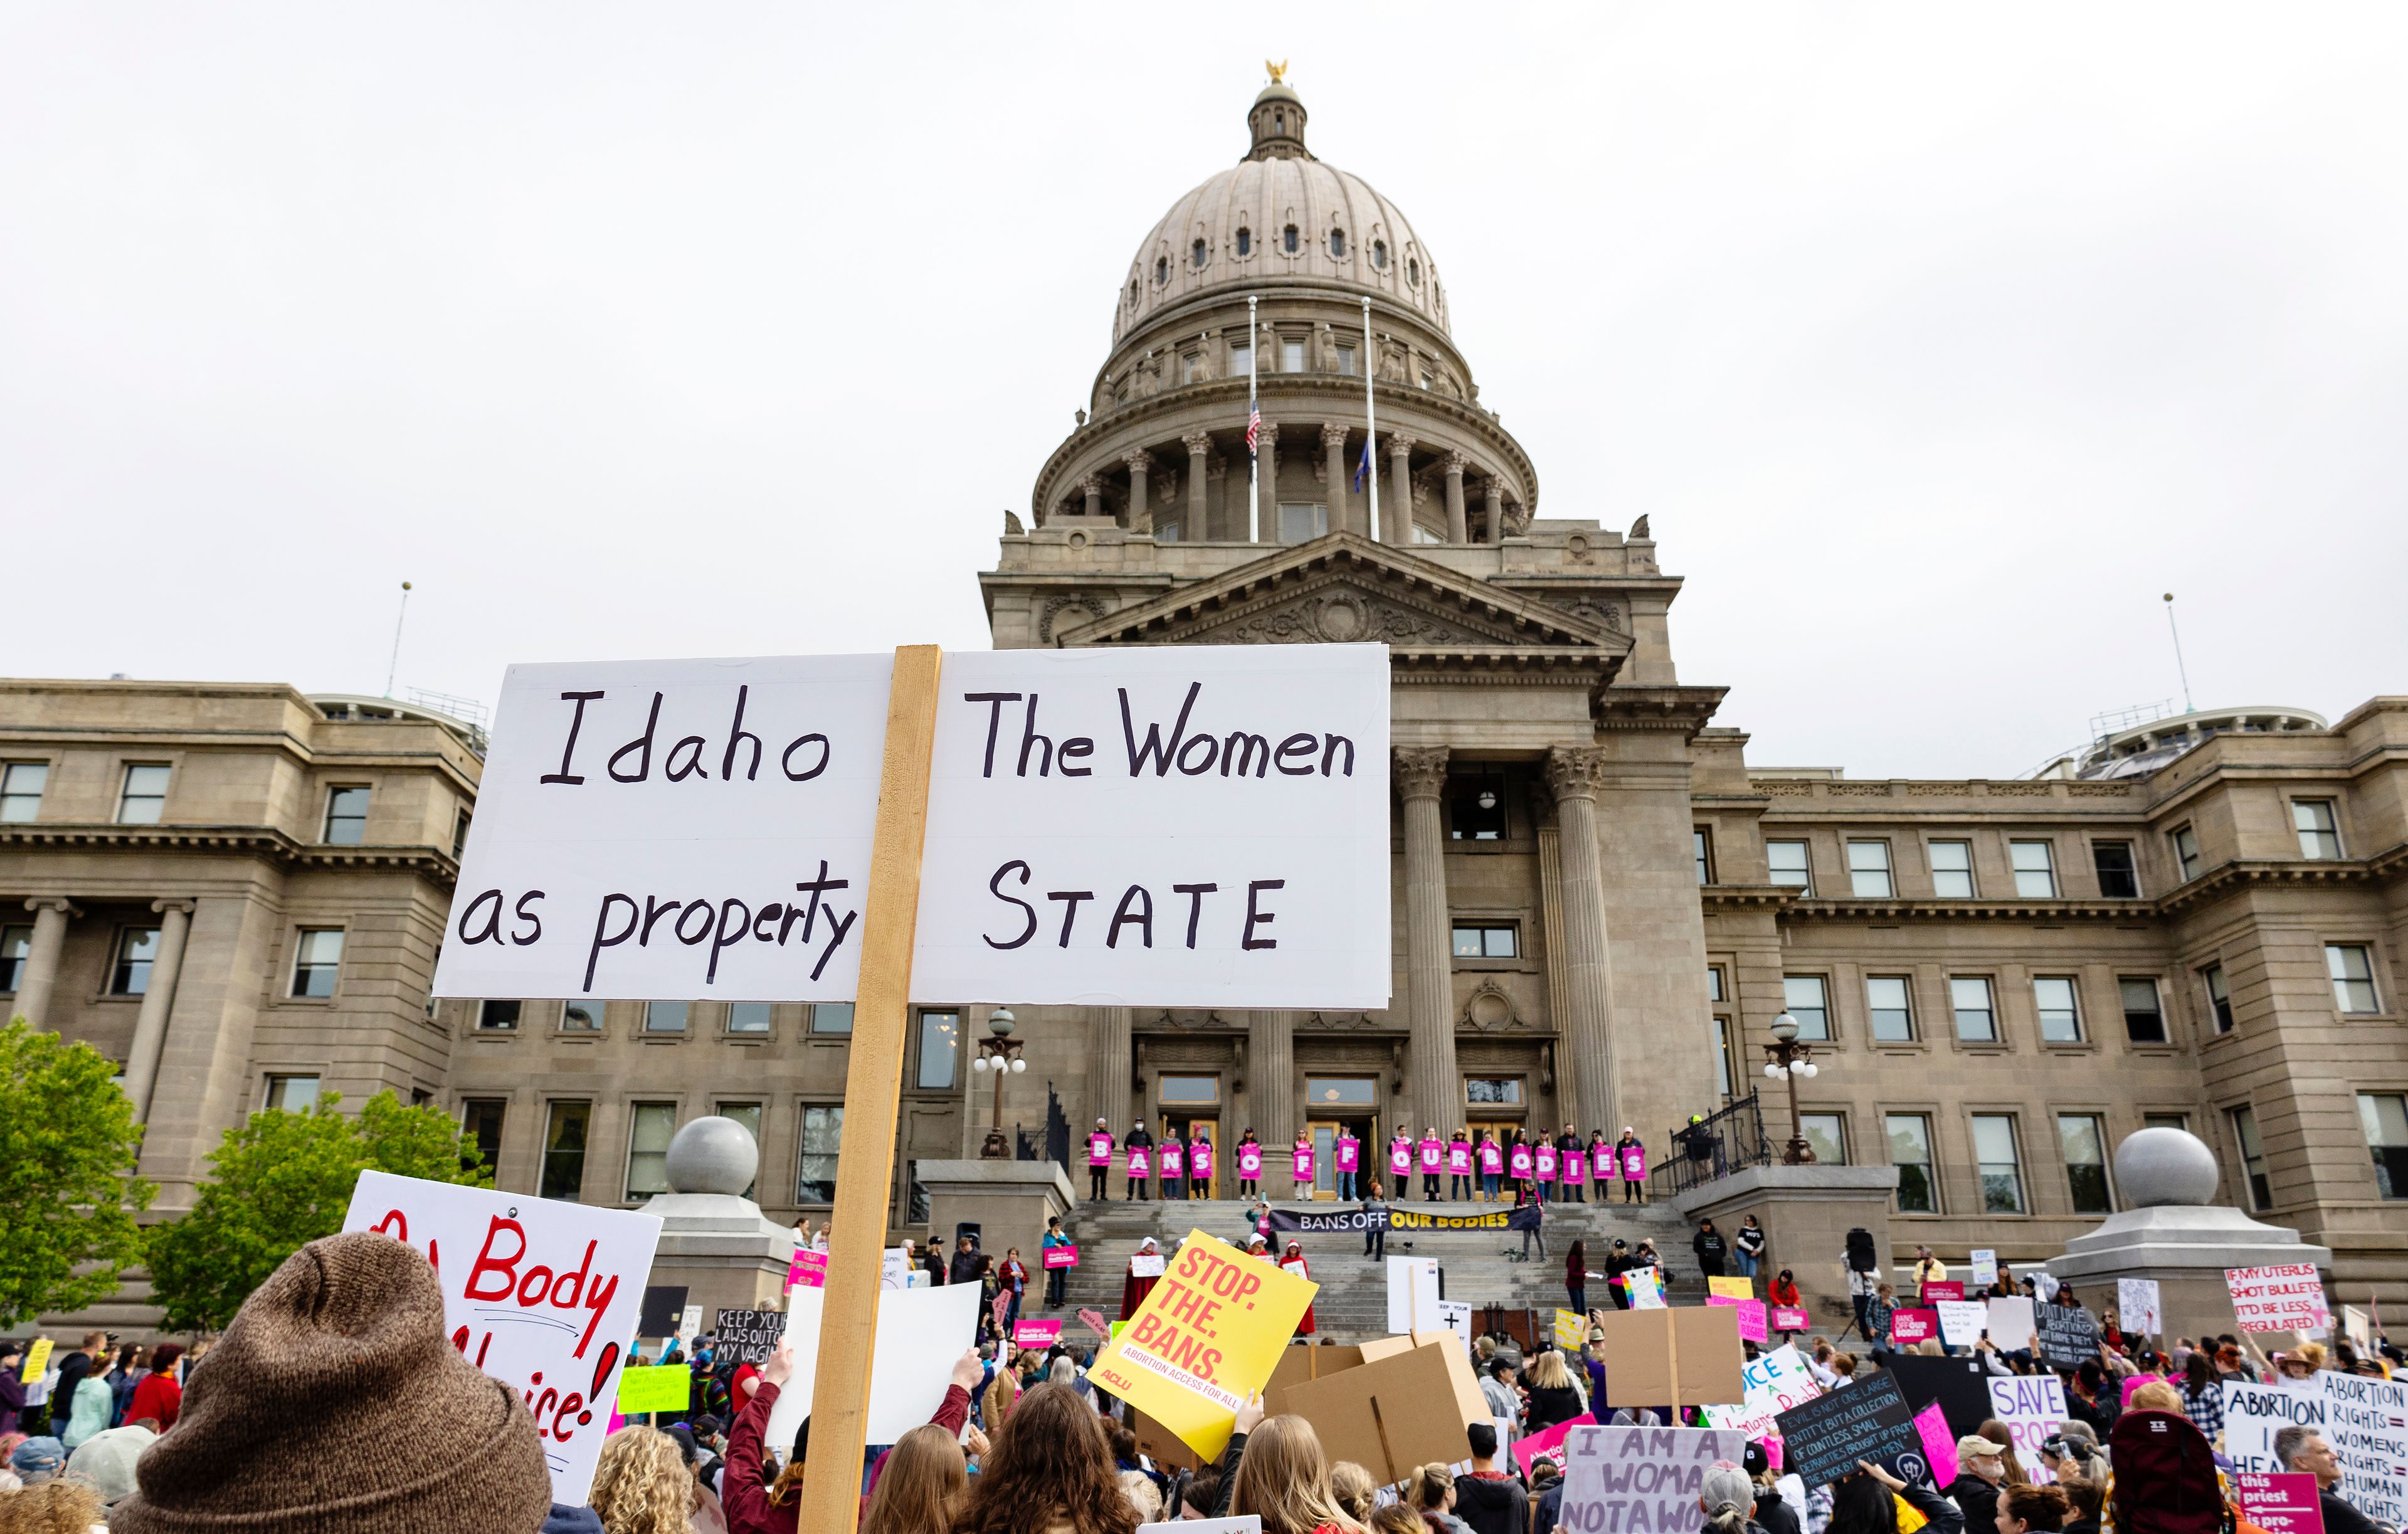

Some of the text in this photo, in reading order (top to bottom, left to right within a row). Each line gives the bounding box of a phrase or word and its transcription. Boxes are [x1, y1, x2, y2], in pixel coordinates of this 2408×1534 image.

[540, 685, 830, 785] Idaho
[964, 682, 1355, 778] The Women
[983, 860, 1285, 950] STATE
[458, 860, 858, 993] as property
[1300, 1212, 1509, 1229] BANS OFF OUR BODIES
[463, 1214, 619, 1360] Body
[1178, 1247, 1261, 1311] STOP.
[2227, 1264, 2315, 1281] IF MY UTERUS
[2230, 1282, 2322, 1298] SHOT BULLETS
[717, 1310, 754, 1328] KEEP
[1158, 1279, 1222, 1339] THE.
[2263, 1303, 2279, 1314] BE
[2281, 1300, 2311, 1313] LESS
[715, 1328, 748, 1343] LAWS
[1895, 1329, 1925, 1337] BODIES
[2239, 1317, 2313, 1333] REGULATED
[716, 1344, 739, 1362] MY
[1131, 1313, 1223, 1386] BANS.
[1101, 1368, 1133, 1391] ACLU
[1124, 1346, 1238, 1409] ABORTION ACCESS FOR ALL
[1743, 1358, 1783, 1394] ICE
[2325, 1375, 2405, 1408] ABORTION
[1821, 1397, 1840, 1414] NOT
[1841, 1389, 1861, 1405] ONE
[1861, 1377, 1892, 1397] LARGE
[1825, 1414, 1844, 1431] BUT
[1852, 1391, 1899, 1419] COLLECTION
[1993, 1378, 2064, 1415] SAVE
[2229, 1389, 2326, 1426] ABORTION
[2333, 1403, 2387, 1430] RIGHTS
[1578, 1428, 1720, 1459] I AM A
[1793, 1447, 1805, 1461] OF
[1852, 1417, 1882, 1436] SMALL
[1799, 1420, 1914, 1474] DEPRAVITIES BROUGHT UP FROM
[2331, 1430, 2405, 1458] WOMENS
[1805, 1473, 1823, 1486] THE
[1822, 1464, 1844, 1480] MUCK
[1843, 1459, 1855, 1471] BY
[2337, 1449, 2390, 1476] RIGHTS
[1602, 1463, 1703, 1496] WOMA
[2240, 1474, 2271, 1487] this
[2345, 1472, 2403, 1498] HUMAN
[2242, 1488, 2288, 1505] priest
[2261, 1515, 2295, 1528] pro-
